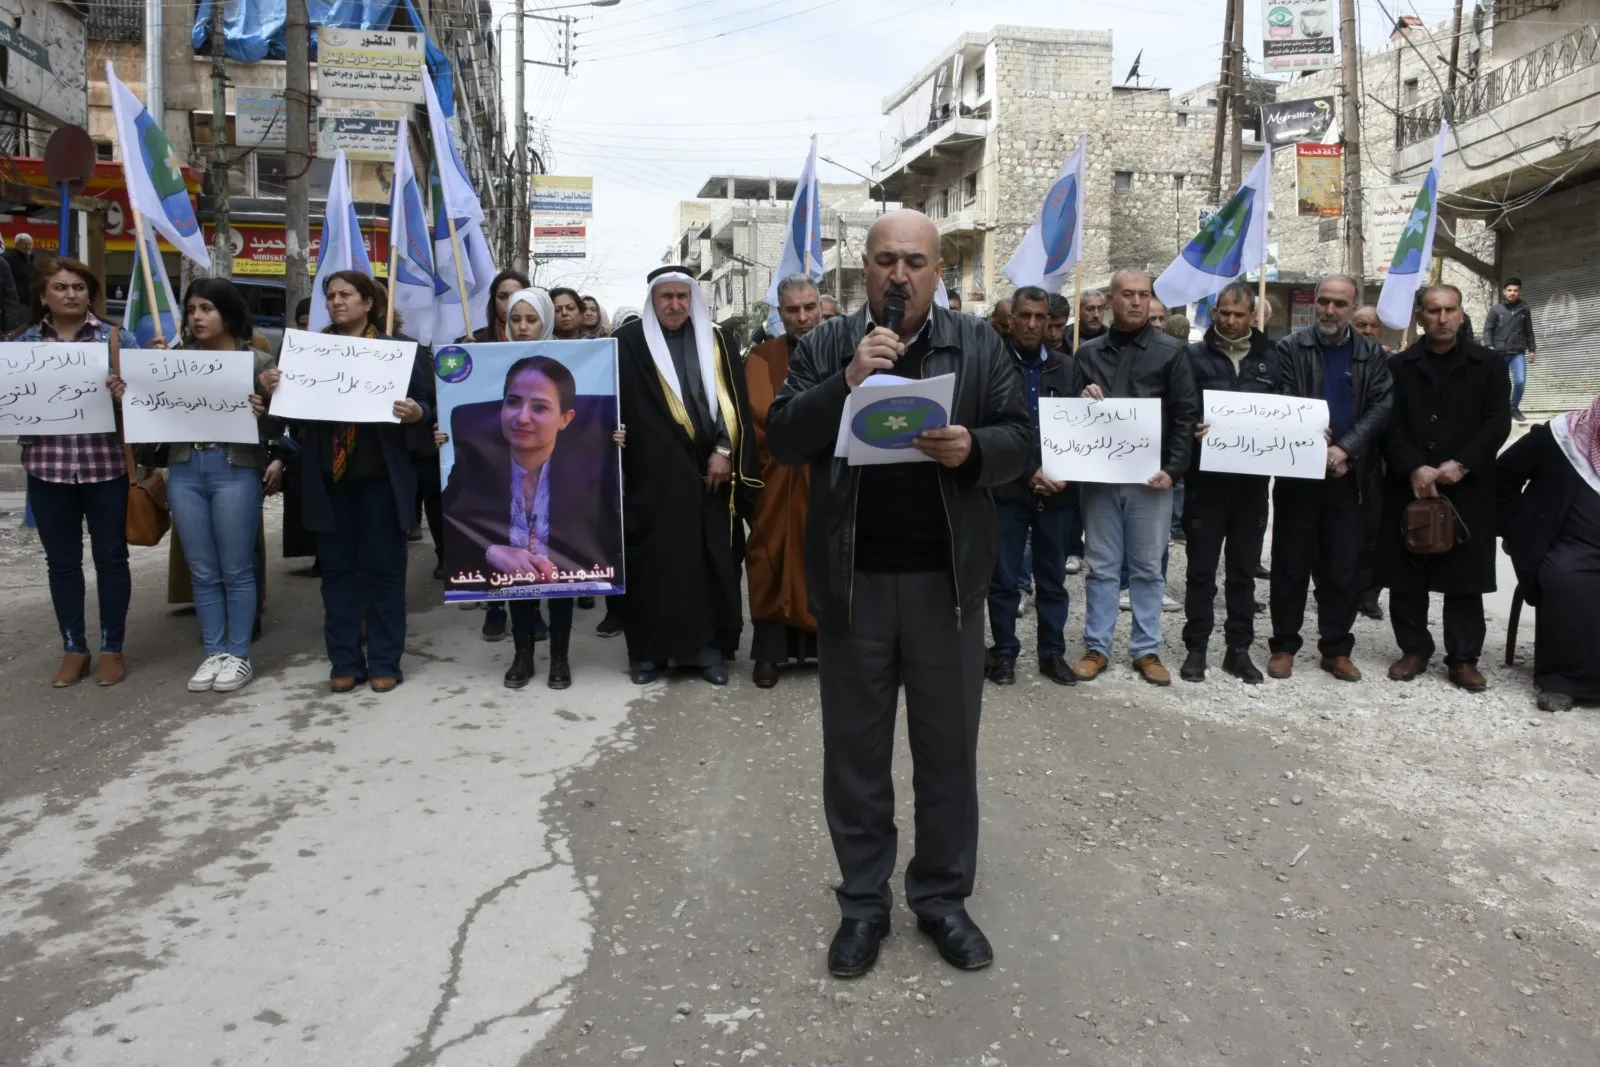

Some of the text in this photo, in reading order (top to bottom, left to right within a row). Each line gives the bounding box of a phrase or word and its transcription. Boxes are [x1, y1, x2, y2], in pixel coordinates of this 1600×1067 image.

[361, 35, 395, 47] الدكتور
[323, 68, 353, 80] وجراحتها
[378, 72, 392, 81] طب
[393, 72, 401, 83] في
[402, 72, 421, 83] دكتور
[339, 119, 396, 134] ليلى حسن
[532, 189, 592, 202] للتحاليل الطبية
[0, 381, 37, 406] للثور
[450, 570, 487, 584] خلف
[490, 569, 537, 586] هفرين
[551, 564, 615, 583] الشهيدة
